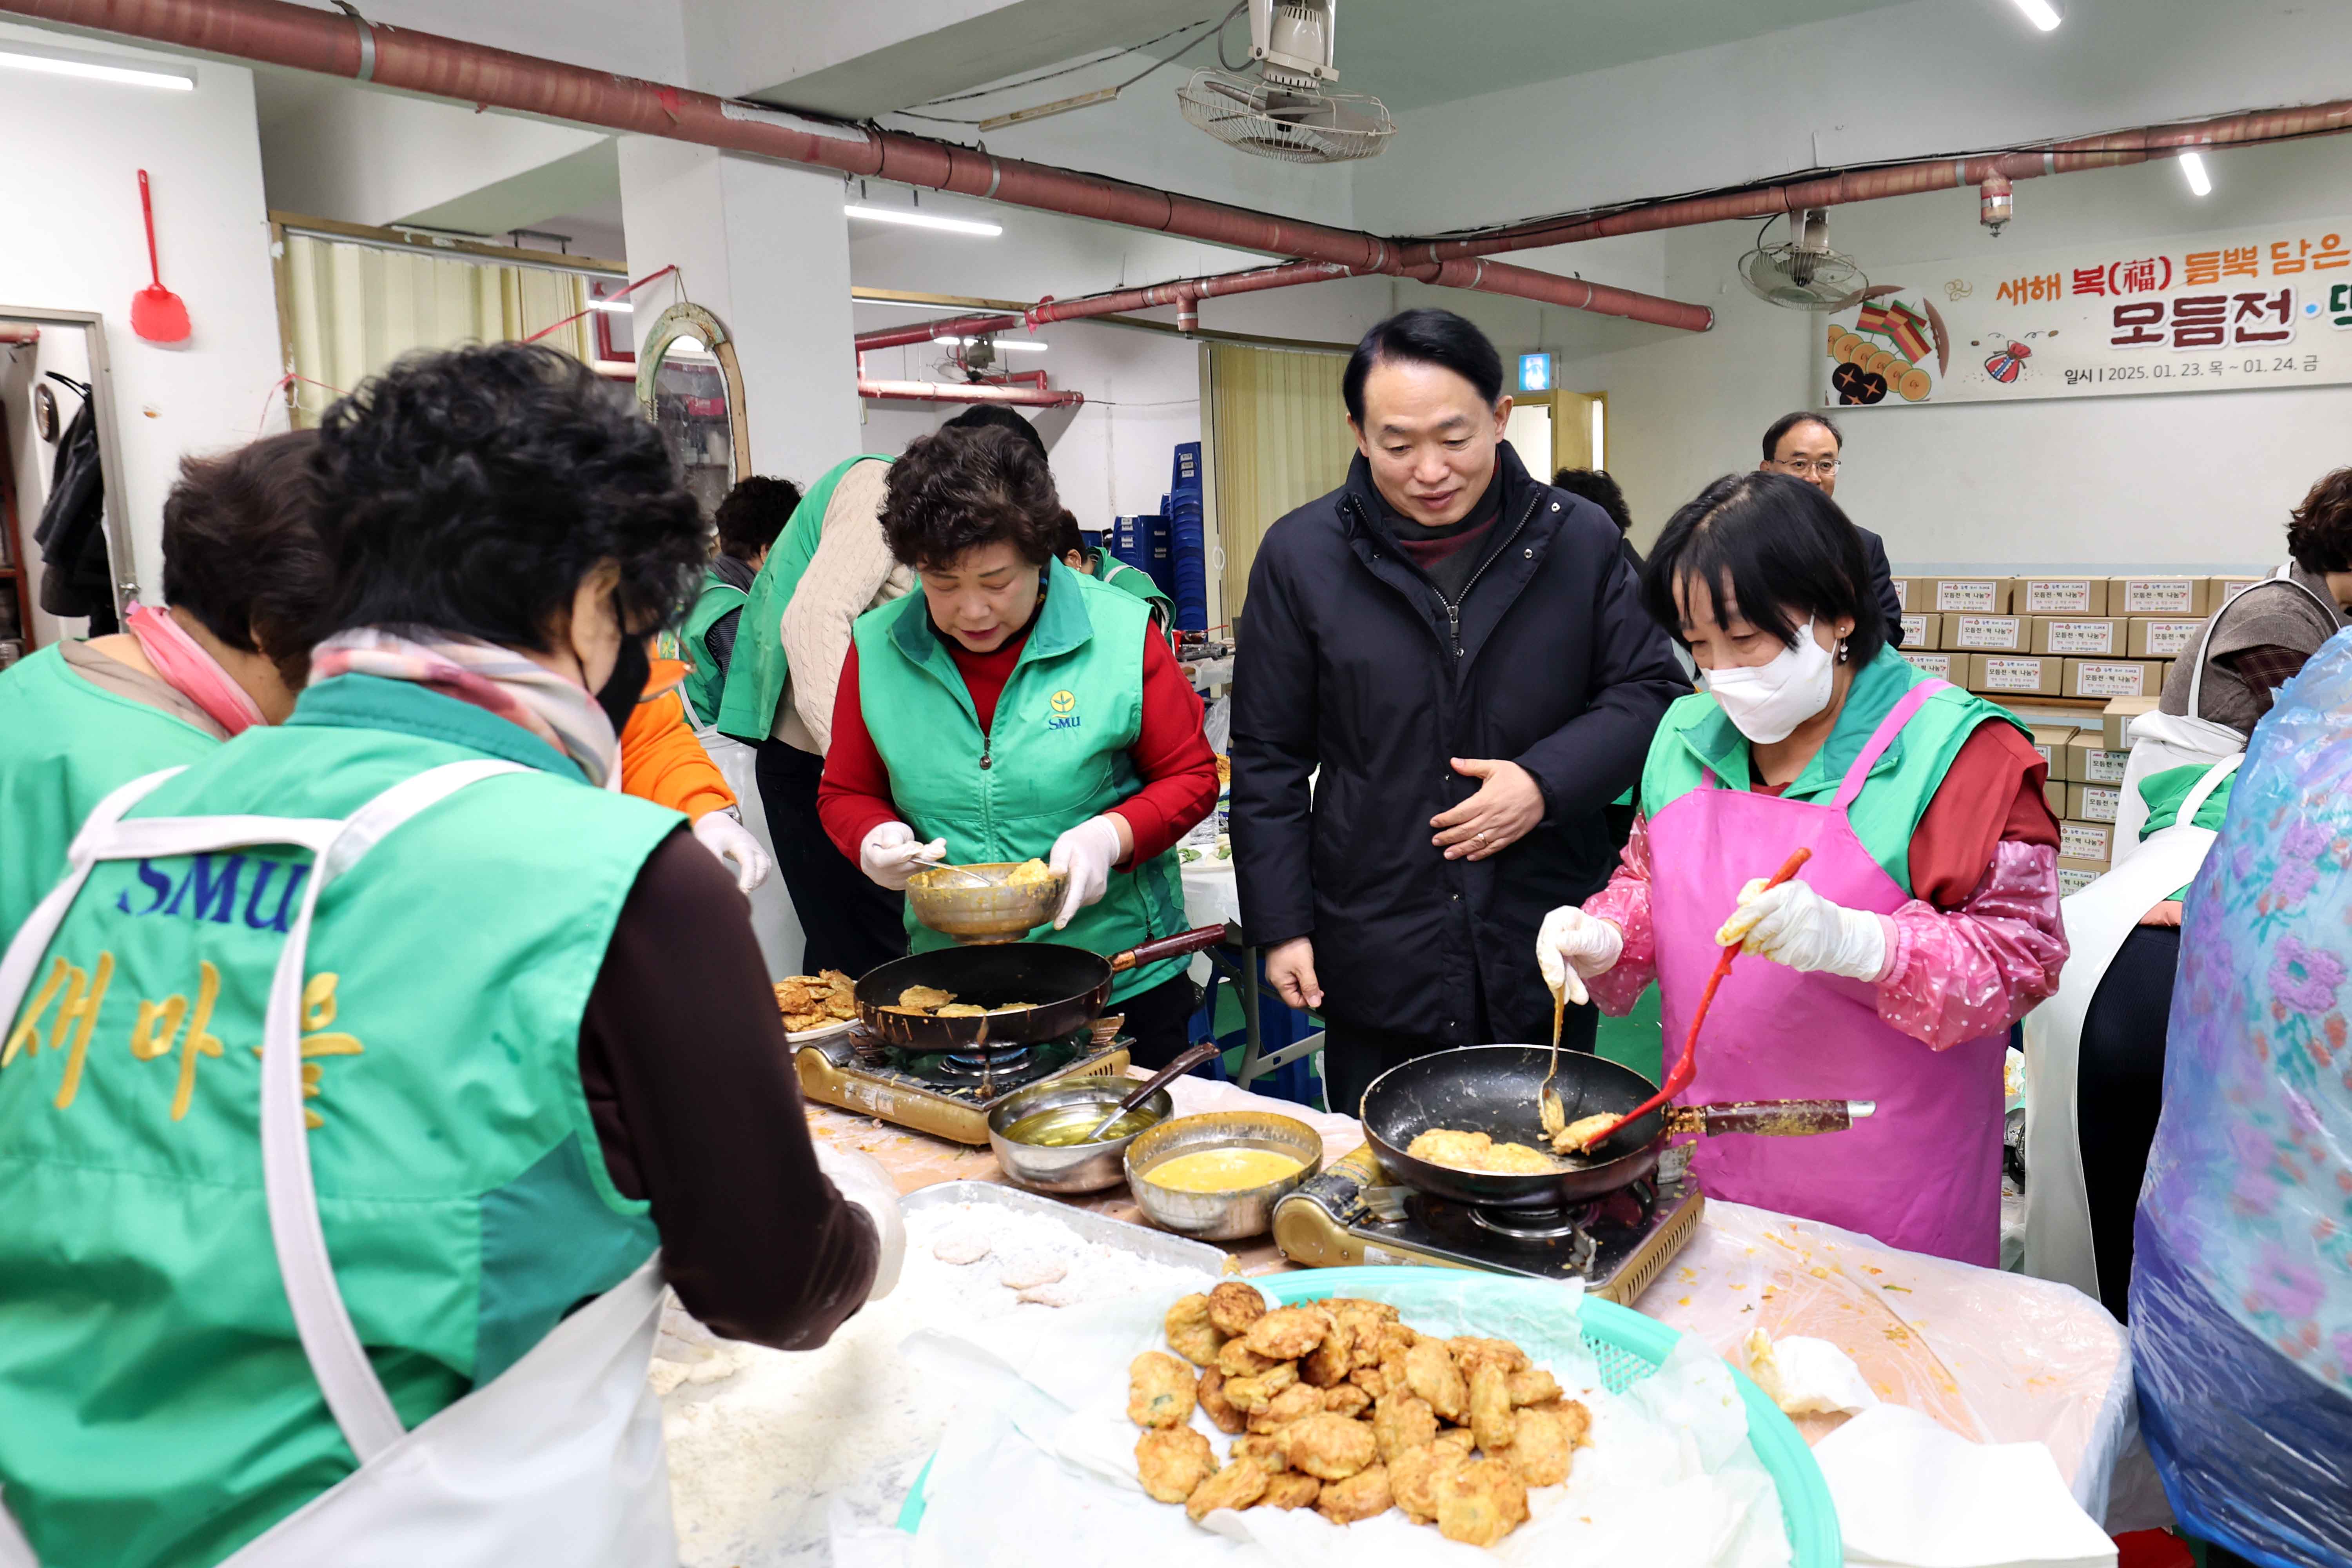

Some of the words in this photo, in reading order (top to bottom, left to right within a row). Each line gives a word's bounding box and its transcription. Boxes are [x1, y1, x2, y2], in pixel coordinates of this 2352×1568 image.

[1996, 272, 2062, 307] 새해
[2072, 256, 2172, 297] 복(福)
[2184, 245, 2259, 286] 듬뿍
[2270, 233, 2351, 276] 담은
[2064, 368, 2092, 385] 일시
[2108, 366, 2149, 381] 2025.
[2153, 364, 2176, 378] 01.
[2181, 363, 2204, 377] 23.
[2209, 360, 2224, 376] 목
[2243, 359, 2268, 373] 01.
[2272, 357, 2298, 372] 24.
[2303, 354, 2319, 372] 금
[1048, 715, 1081, 730] SMU
[115, 851, 312, 933] SMU
